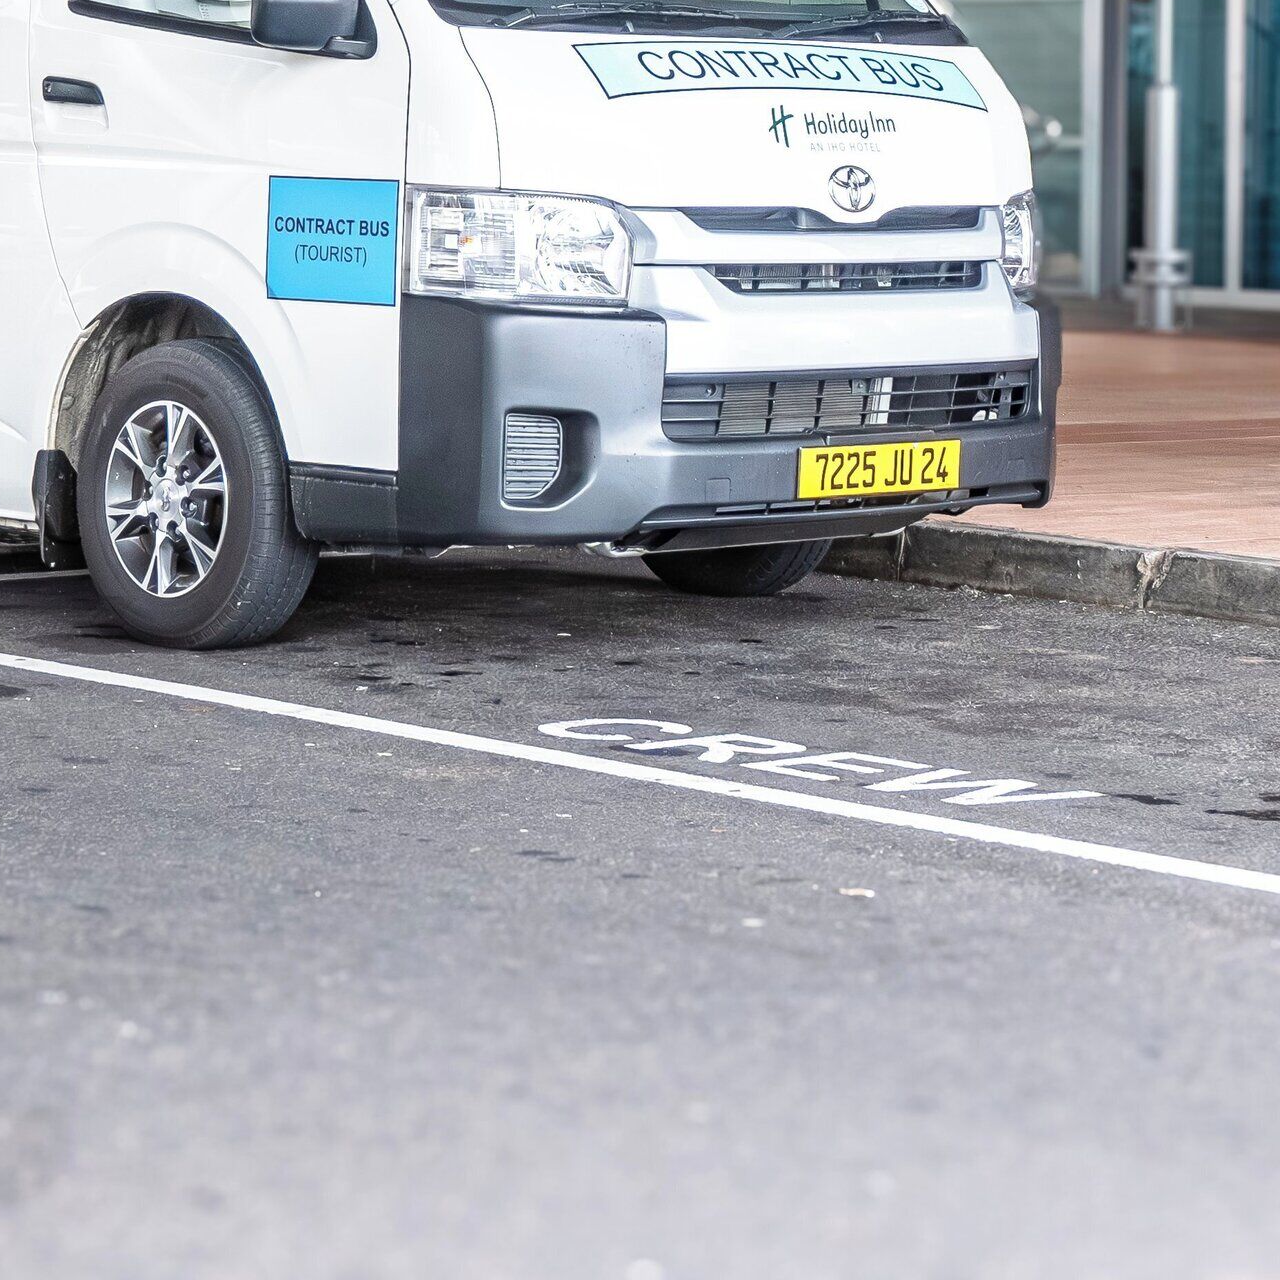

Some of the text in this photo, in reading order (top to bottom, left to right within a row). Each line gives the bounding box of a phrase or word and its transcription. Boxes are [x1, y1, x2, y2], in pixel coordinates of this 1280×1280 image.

[636, 49, 945, 91] CONTRACT BUS
[810, 142, 881, 153] AN IHG HOTEL
[274, 216, 390, 237] CONTRACT BUS
[295, 244, 367, 268] (TOURIST)
[816, 447, 949, 491] 7225 JU 24
[537, 717, 1107, 806] CREW
